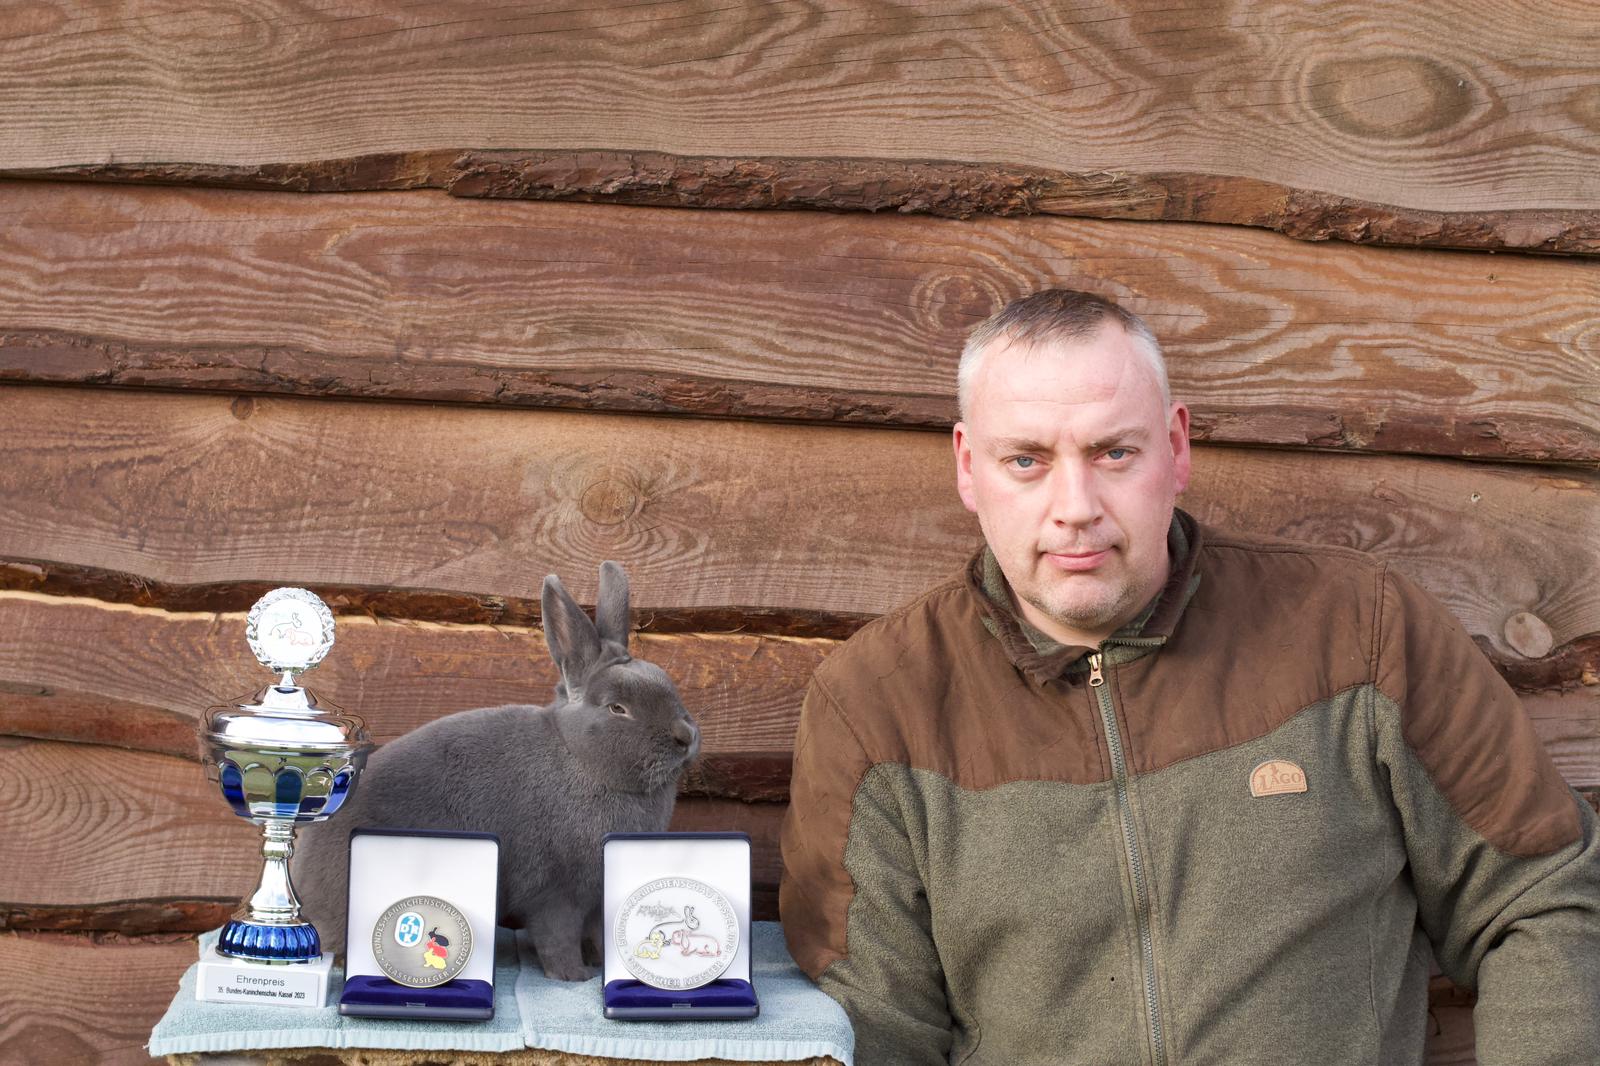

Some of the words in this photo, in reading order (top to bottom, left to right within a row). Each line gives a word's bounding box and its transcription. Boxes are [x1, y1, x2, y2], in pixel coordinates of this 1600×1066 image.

[456, 915, 471, 945] KASSEL
[236, 974, 285, 987] Ehrenpreis
[383, 961, 450, 983] KLASSENSIEGER
[226, 987, 277, 997] Bundes-Kaninchenschau
[278, 990, 293, 999] Kassel
[294, 991, 305, 999] 2023
